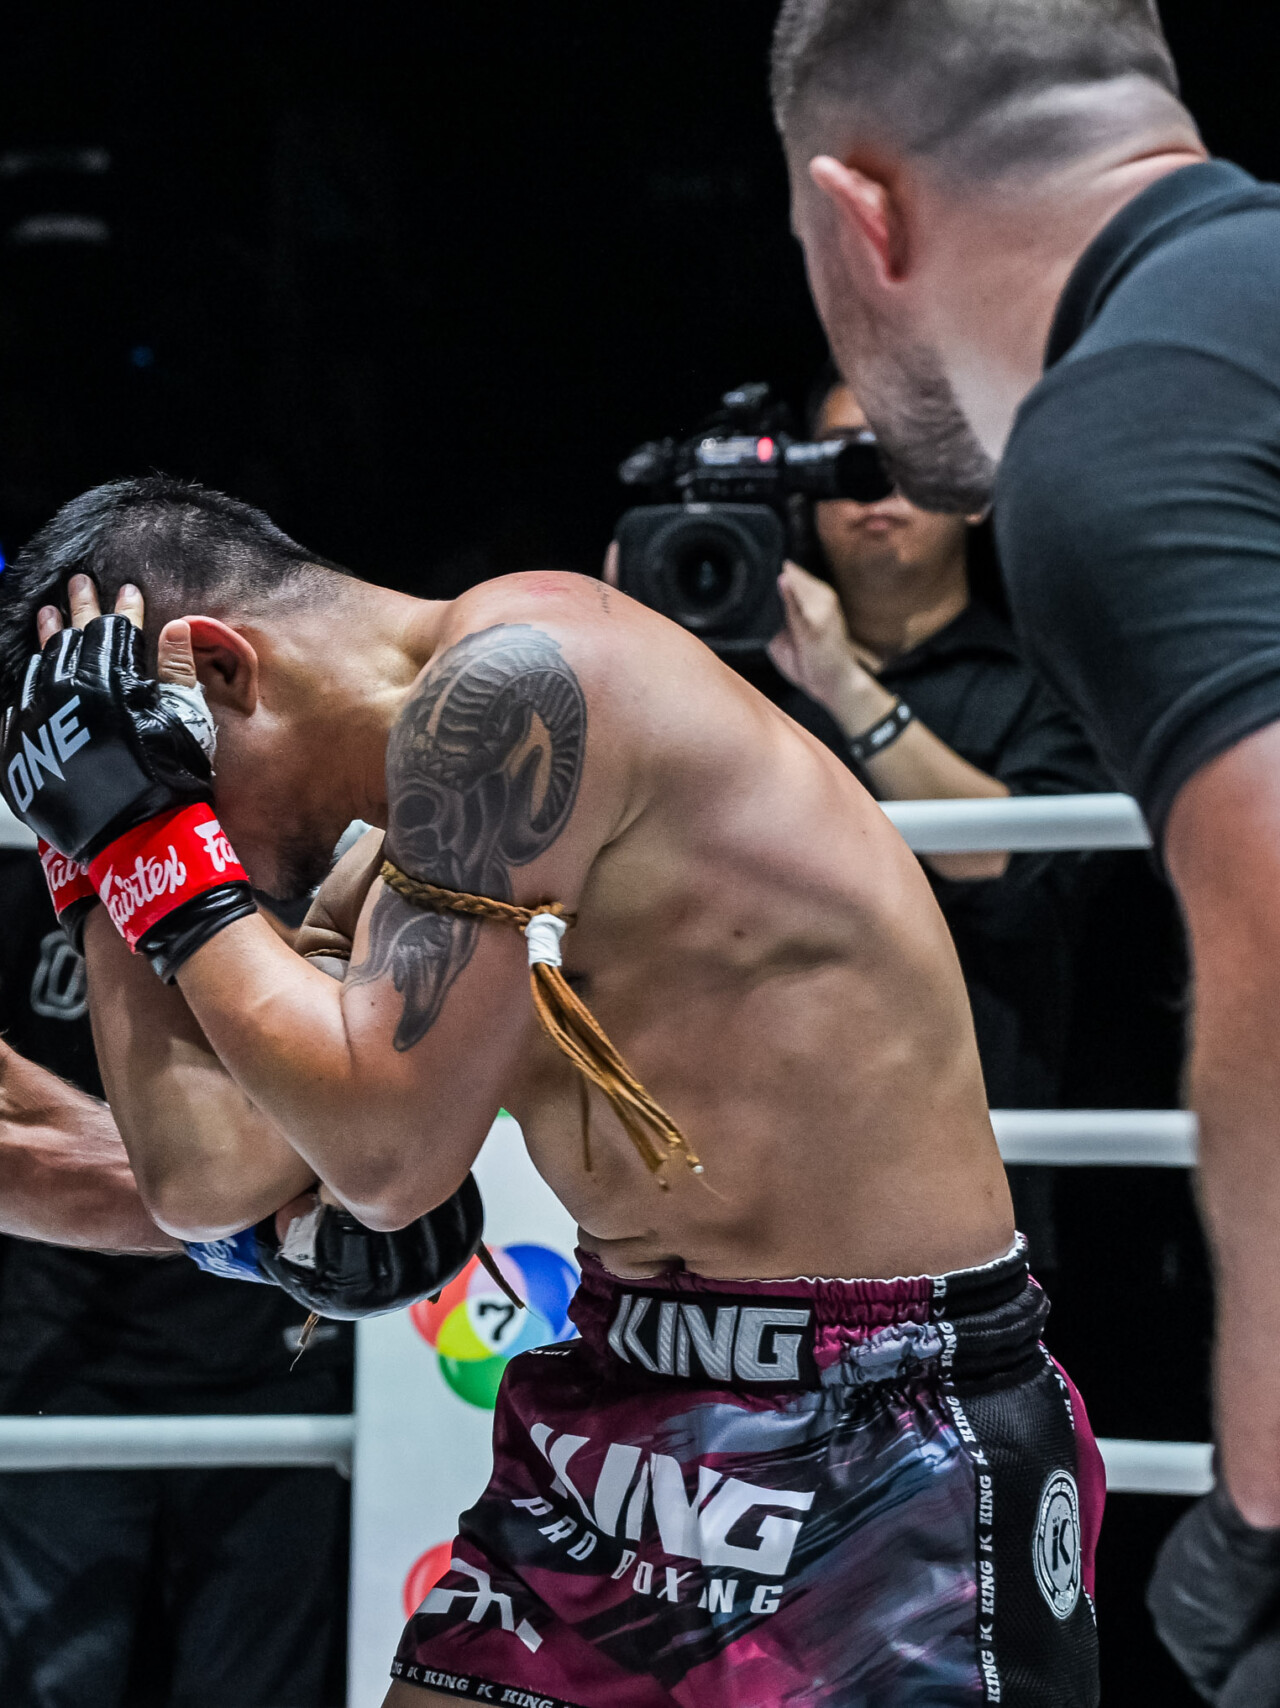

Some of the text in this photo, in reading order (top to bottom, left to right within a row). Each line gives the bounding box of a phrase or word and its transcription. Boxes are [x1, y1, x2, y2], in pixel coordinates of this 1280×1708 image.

[8, 695, 91, 813] ONE
[99, 845, 187, 938] Fairtex
[477, 1301, 516, 1342] 7
[608, 1294, 810, 1381] KING
[946, 1395, 977, 1443] KING
[530, 1422, 816, 1576] KING
[979, 1475, 993, 1526] KING
[511, 1496, 598, 1561] PRO
[980, 1561, 995, 1616] KING
[423, 1670, 469, 1691] KING
[500, 1688, 554, 1708] KING
[981, 1650, 1001, 1704] KING
